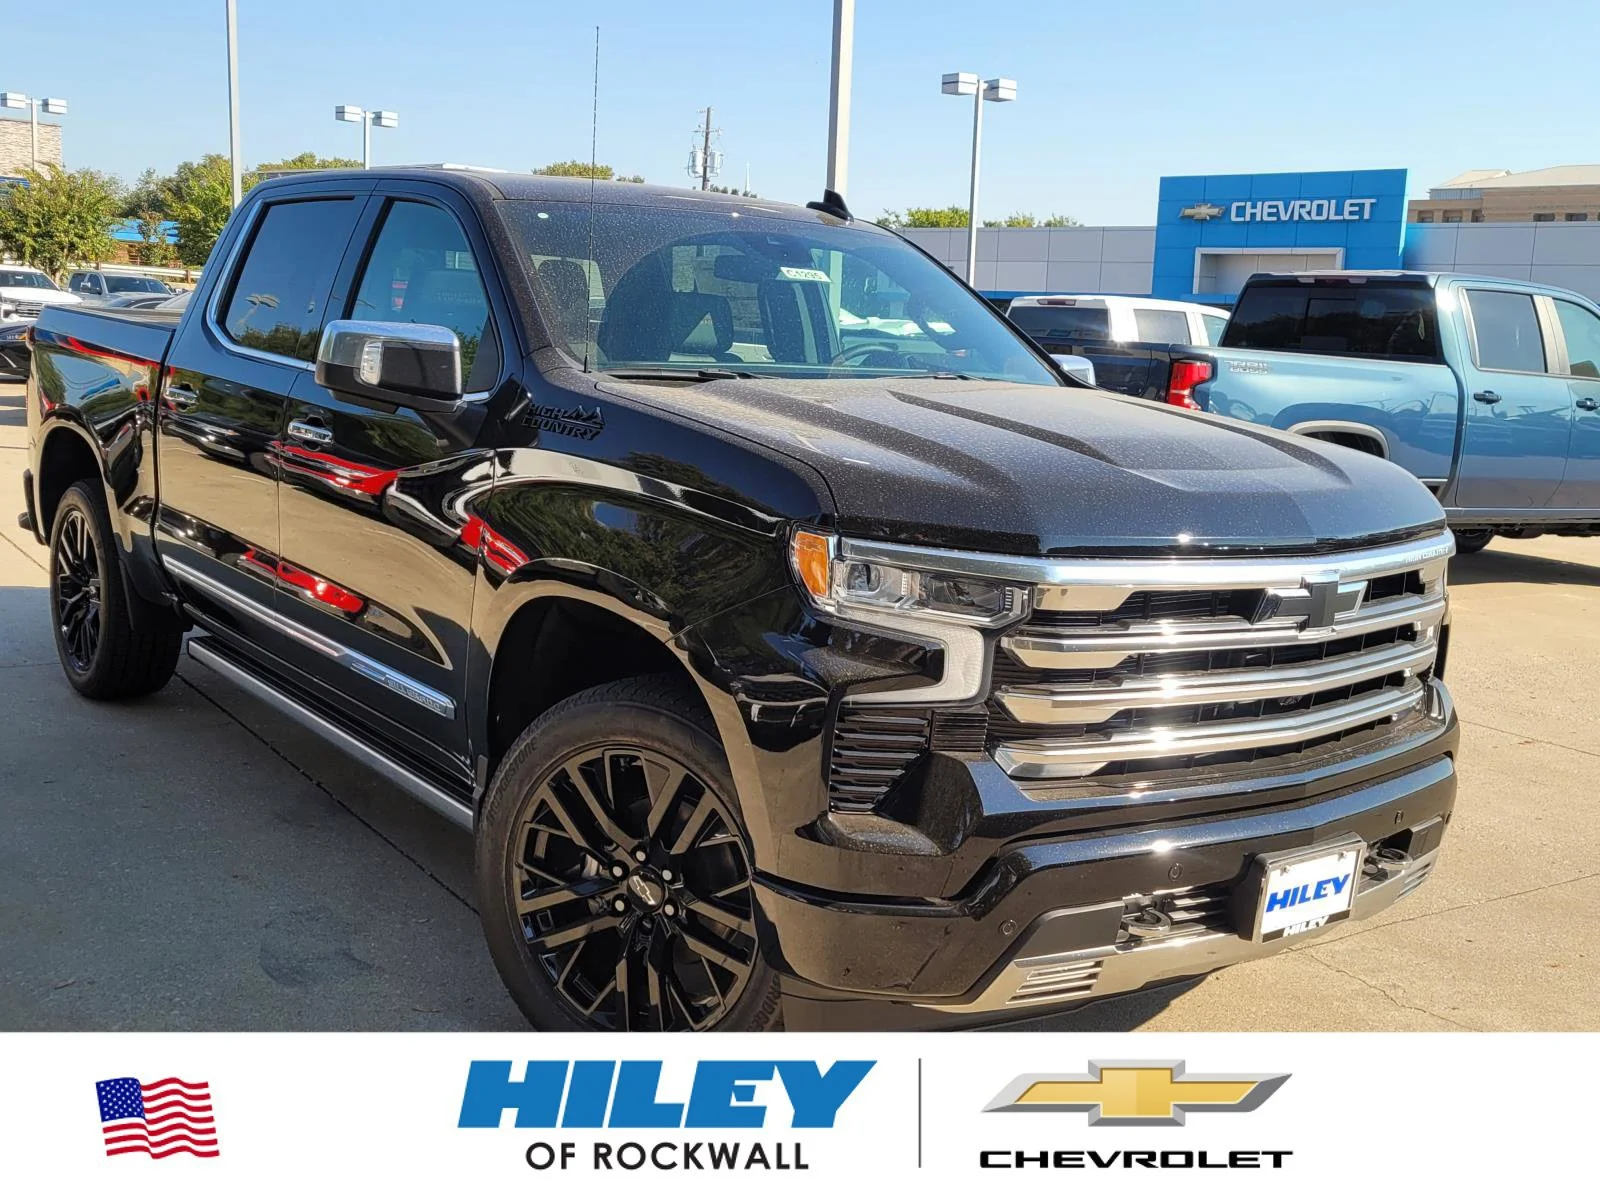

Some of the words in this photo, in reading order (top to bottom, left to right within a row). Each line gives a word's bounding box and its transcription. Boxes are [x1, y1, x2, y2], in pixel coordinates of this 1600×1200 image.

[1231, 198, 1377, 222] CHEVROLET
[525, 402, 565, 420] HIGH
[521, 416, 601, 440] COUNTRY
[1265, 873, 1351, 913] HILEY
